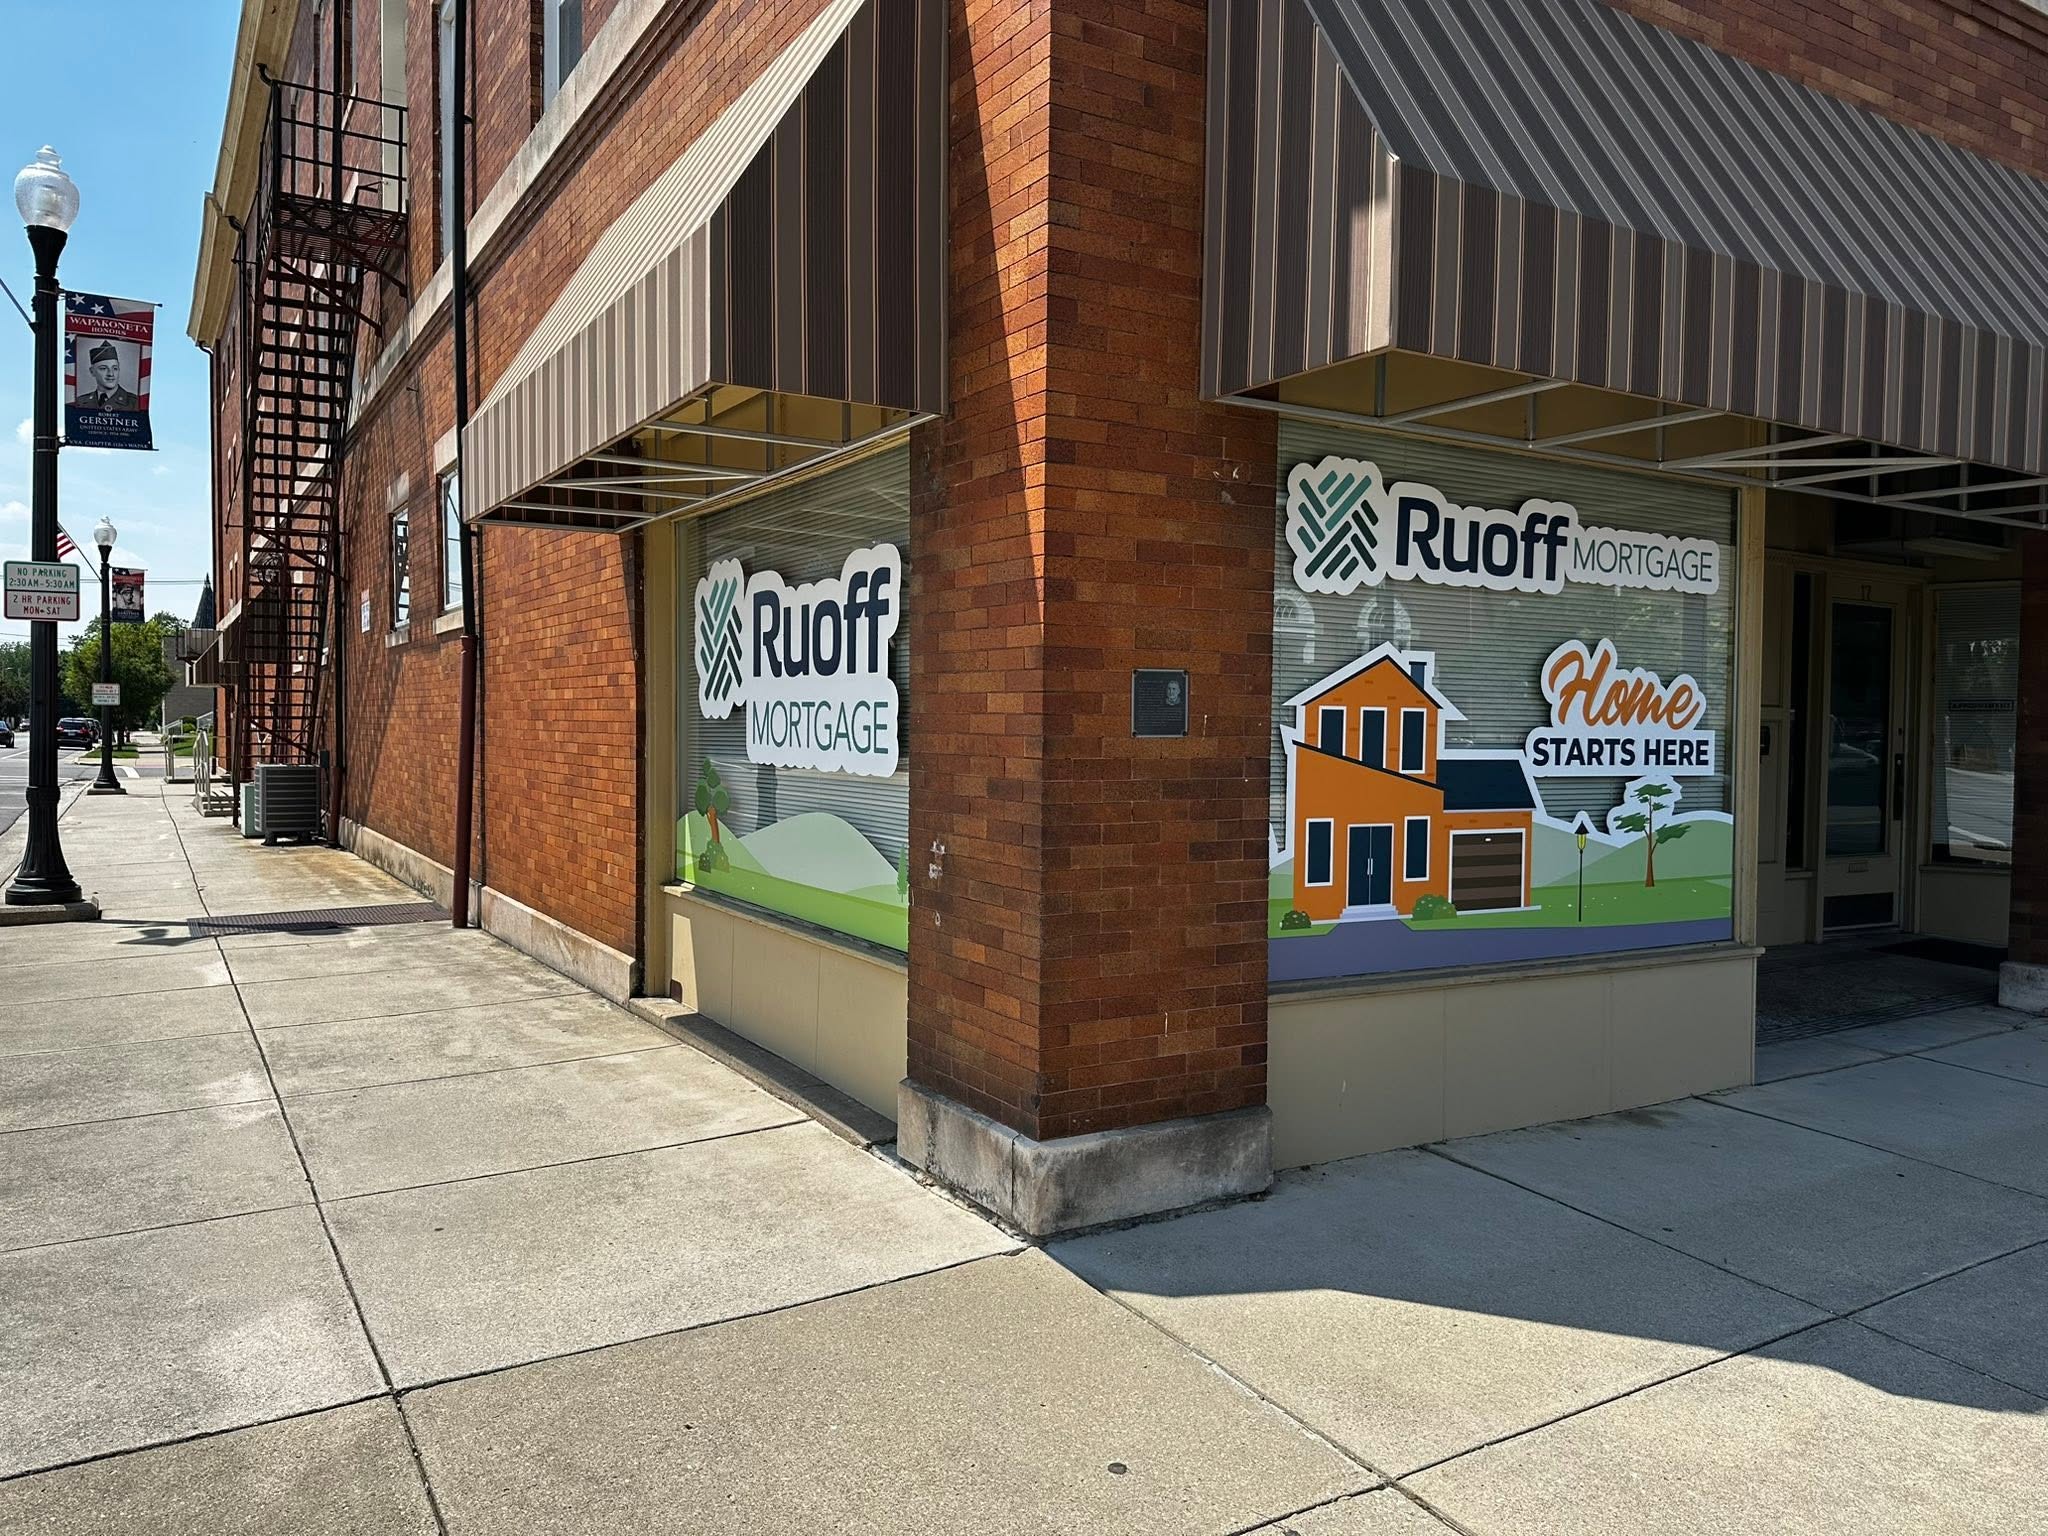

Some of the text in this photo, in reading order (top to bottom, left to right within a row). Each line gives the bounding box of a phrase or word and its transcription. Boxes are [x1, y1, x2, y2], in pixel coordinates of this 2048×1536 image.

[69, 316, 148, 333] WAPAKONETA
[91, 327, 127, 336] HONORS
[79, 416, 139, 427] GERSTNER
[1395, 496, 1713, 583] Ruoff MORTGAGE
[17, 567, 67, 578] NO PARKING
[13, 594, 71, 605] 2 HR PARKING
[753, 566, 891, 678] Ruoff
[1548, 648, 1701, 730] Home
[752, 700, 889, 754] MORTGAGE
[1532, 736, 1709, 767] STARTS HERE
